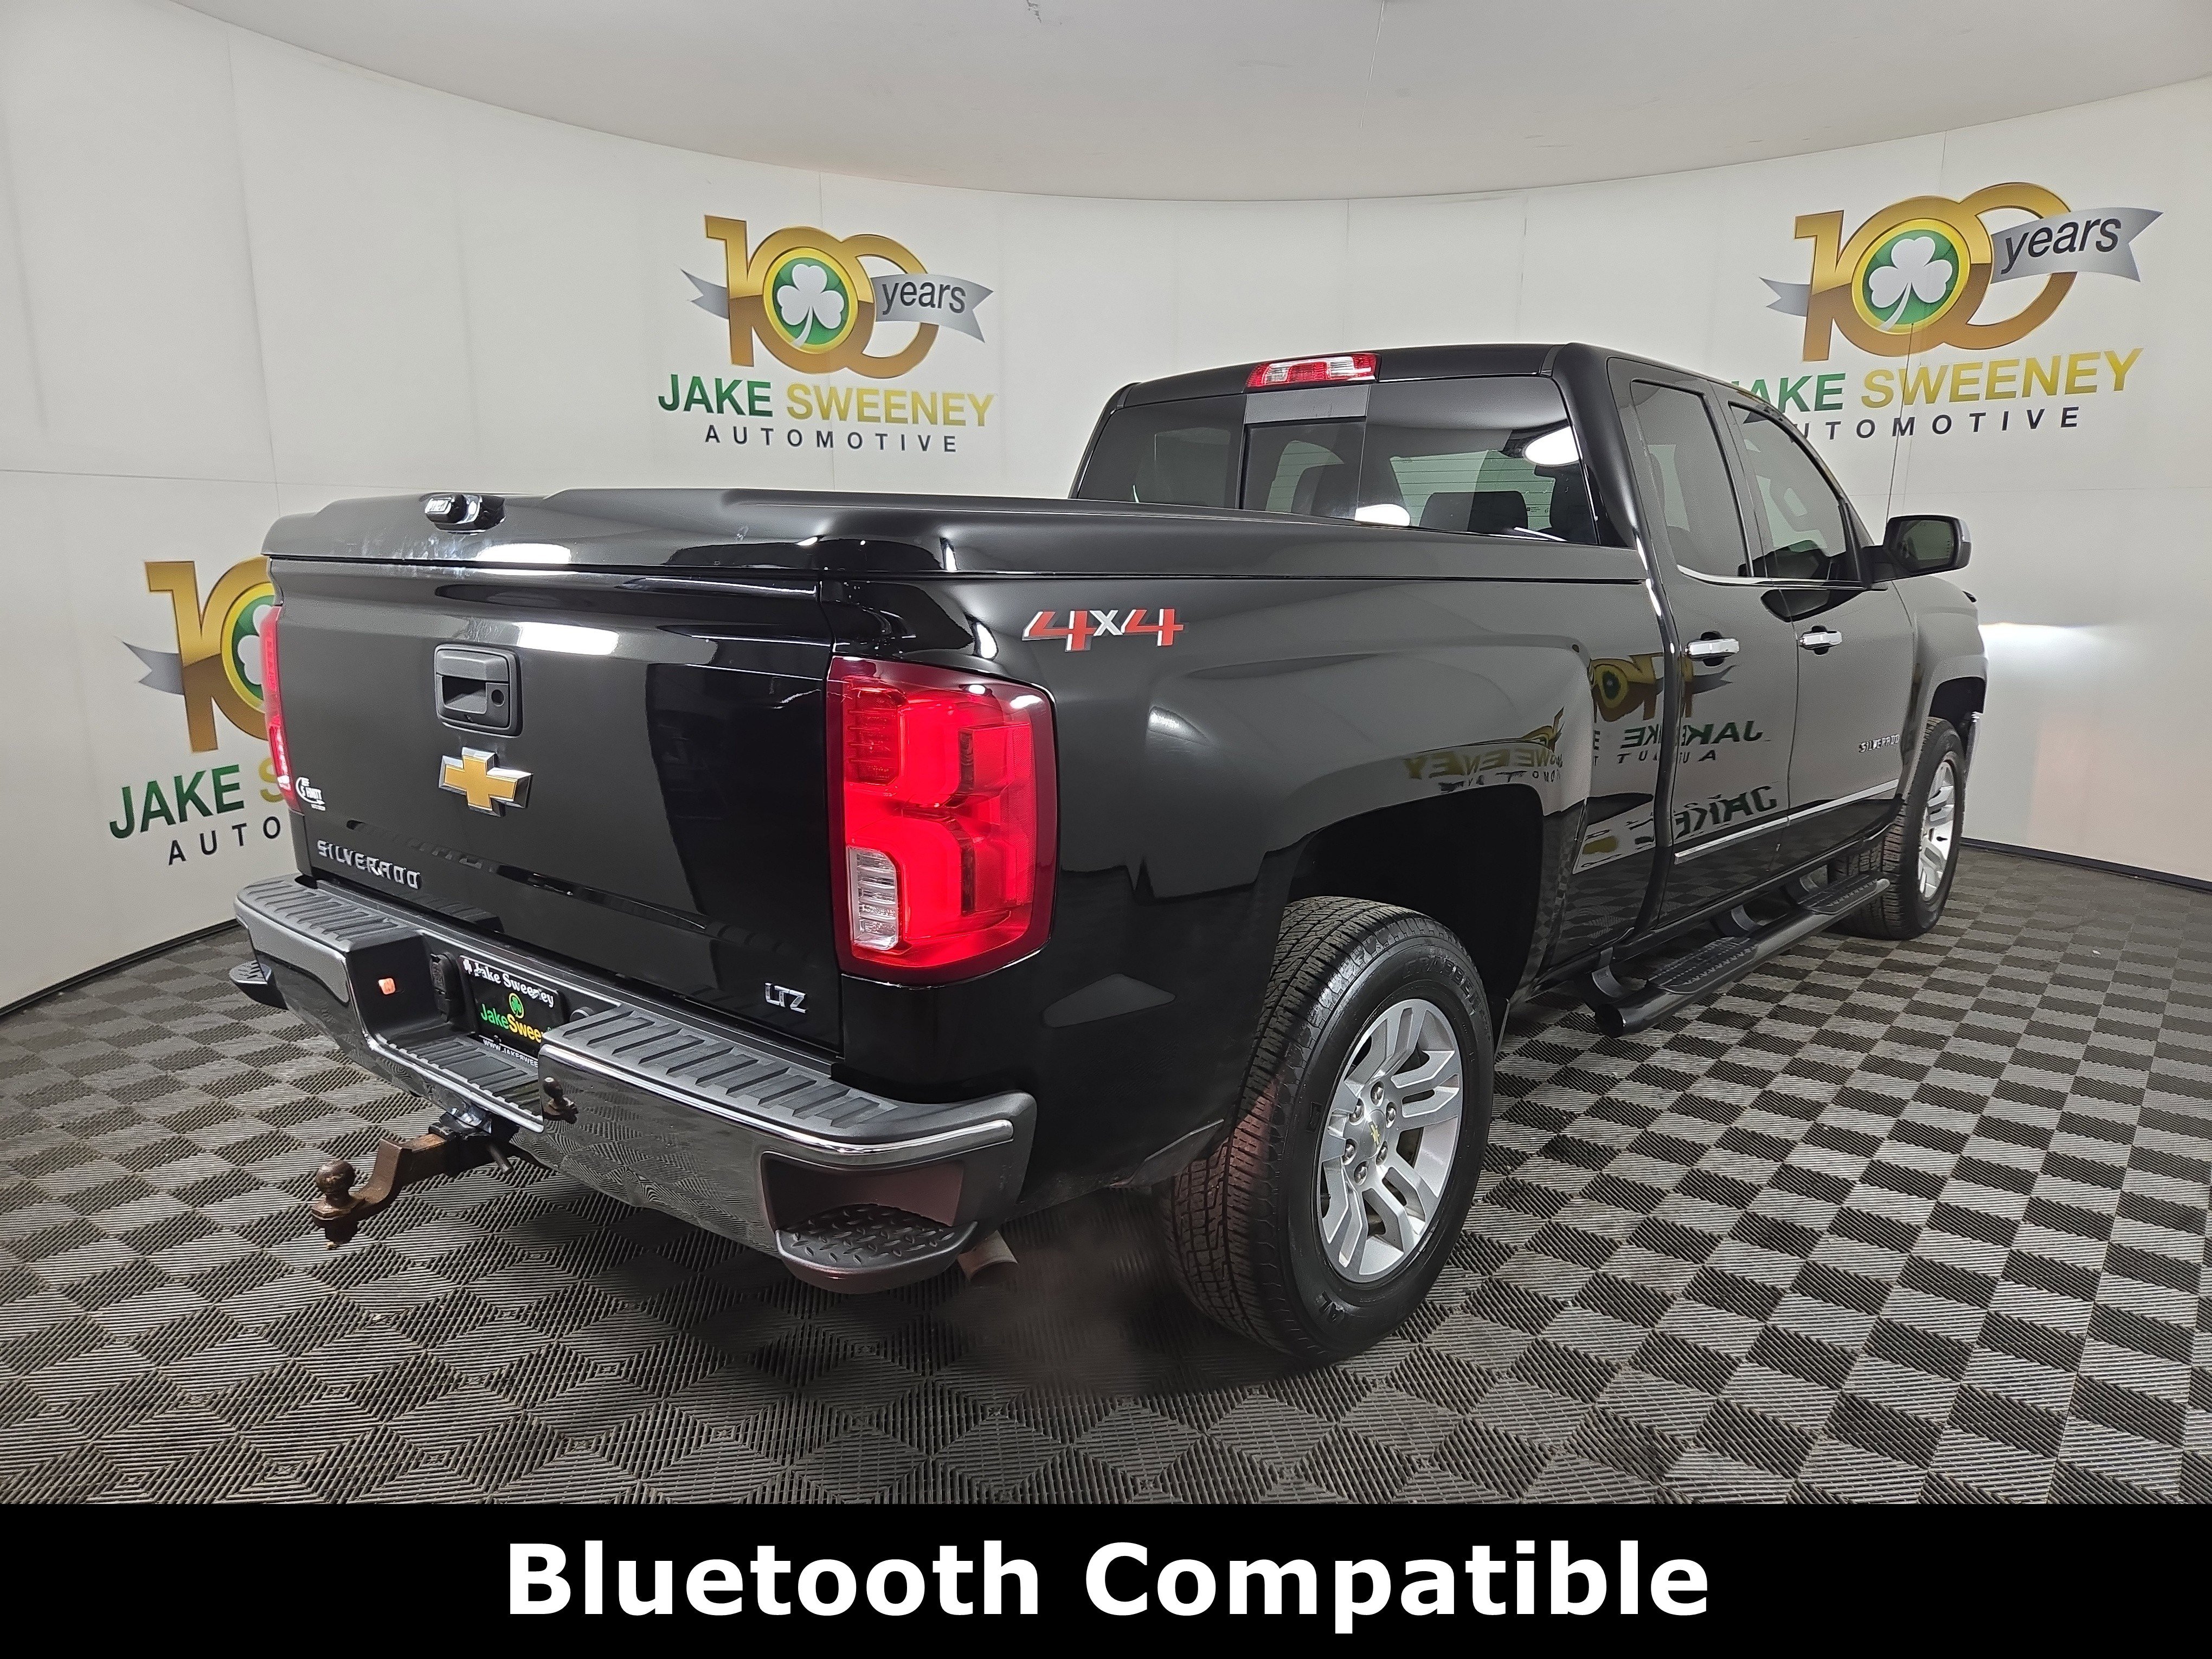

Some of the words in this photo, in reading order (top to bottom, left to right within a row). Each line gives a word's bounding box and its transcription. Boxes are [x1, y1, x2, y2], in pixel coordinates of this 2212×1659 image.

[2000, 217, 2122, 274] years
[705, 215, 939, 379] 100
[882, 281, 967, 314] years
[1795, 182, 2078, 362] 100
[658, 374, 773, 417] JAKE
[787, 383, 995, 427] SWEENEY
[1732, 373, 1846, 413] AKE
[1861, 348, 2144, 409] SWEENEY
[705, 425, 956, 453] AUTOMOTIVE
[1859, 734, 1901, 753] SILVERADO
[109, 764, 245, 839] JAKE
[317, 840, 421, 890] SILVERADO
[480, 1003, 543, 1043] JakeSwee
[764, 982, 807, 1014] LTZ
